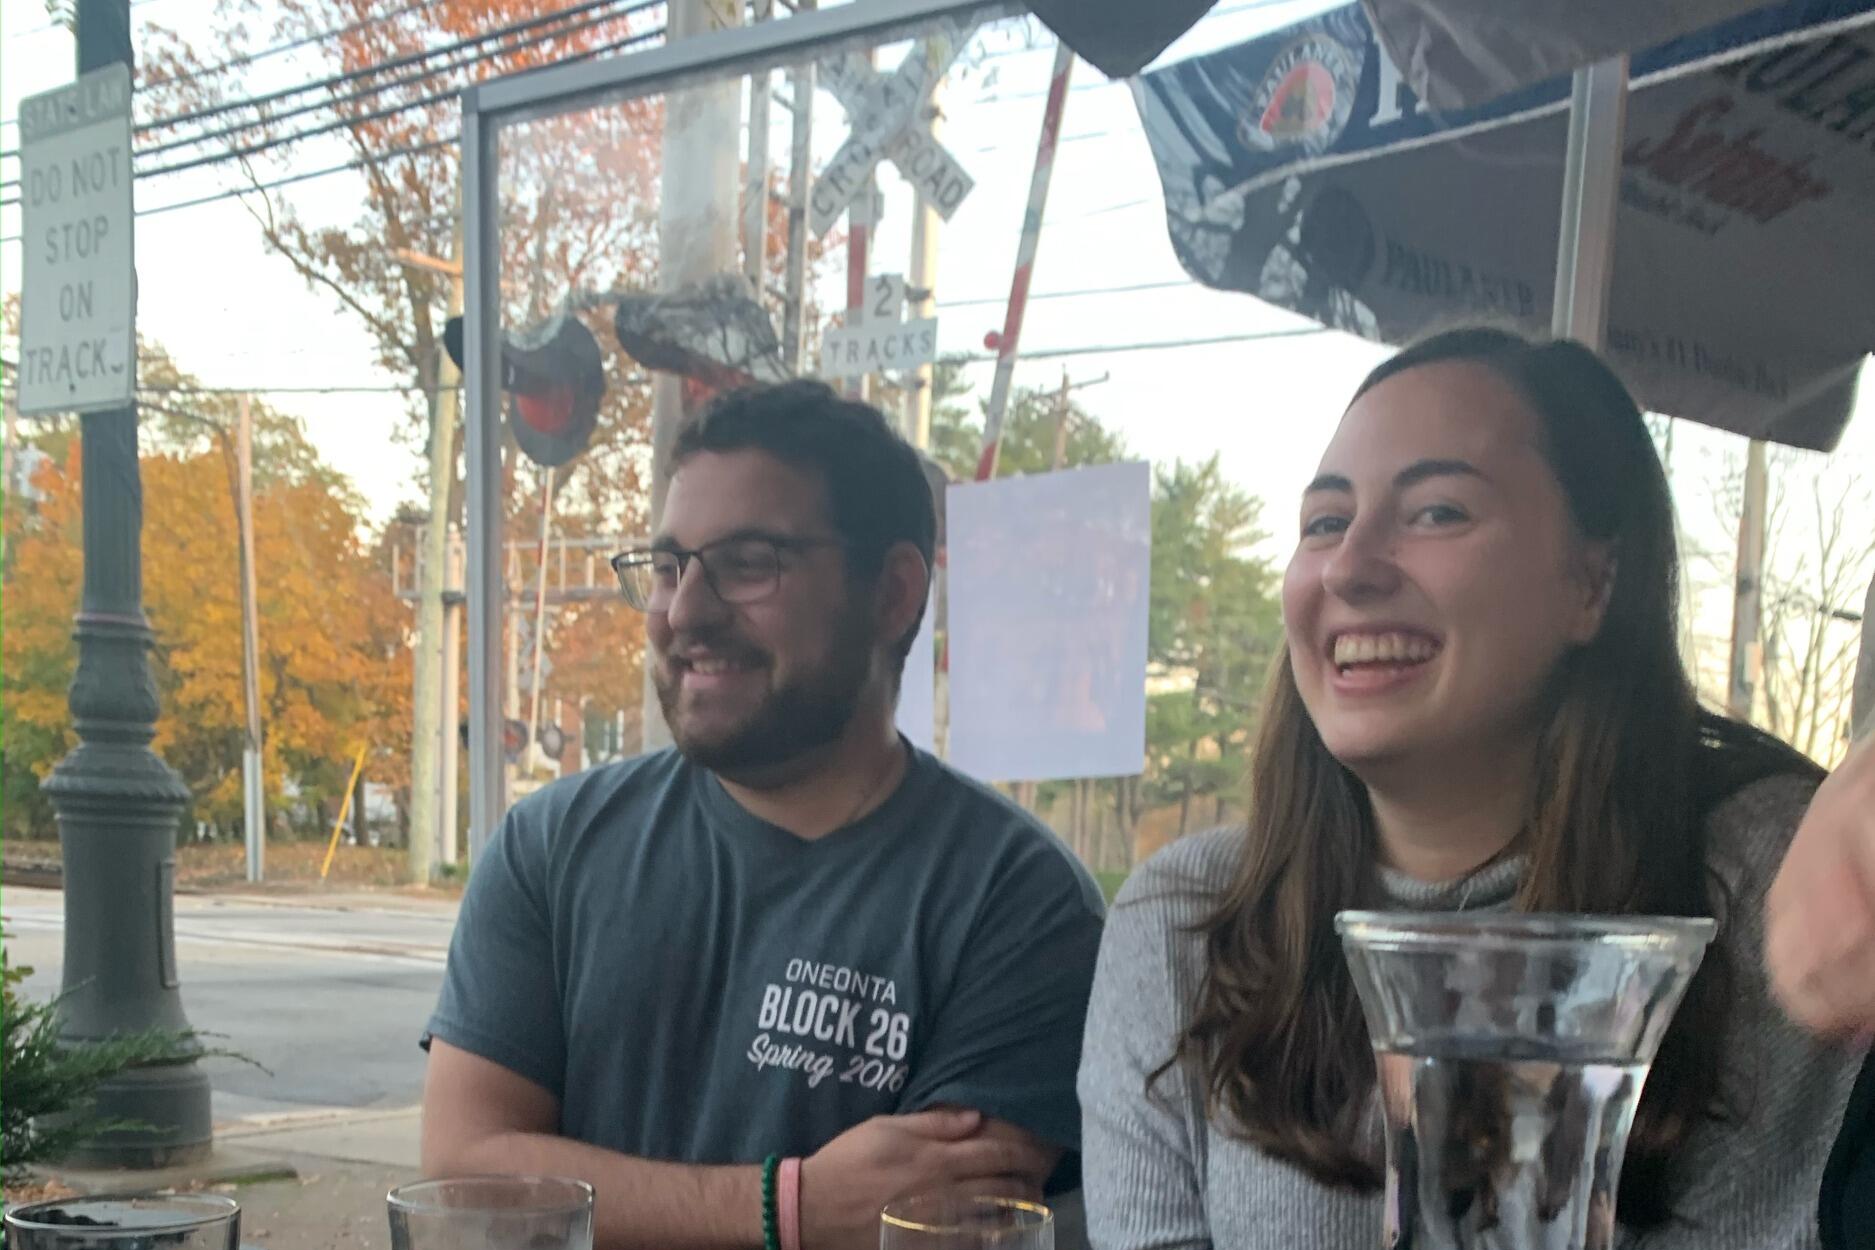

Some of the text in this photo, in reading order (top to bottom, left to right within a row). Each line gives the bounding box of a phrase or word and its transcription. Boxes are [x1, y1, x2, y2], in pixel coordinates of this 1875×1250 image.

[31, 146, 119, 207] DO NOT
[45, 215, 109, 265] STOP
[59, 280, 93, 322] ON
[874, 279, 893, 317] 2
[26, 336, 124, 385] TRACK
[830, 330, 932, 363] TRACKS
[785, 958, 896, 1006] ONEONTA
[758, 983, 910, 1062] BLOCK 26
[747, 1032, 834, 1088] Spring
